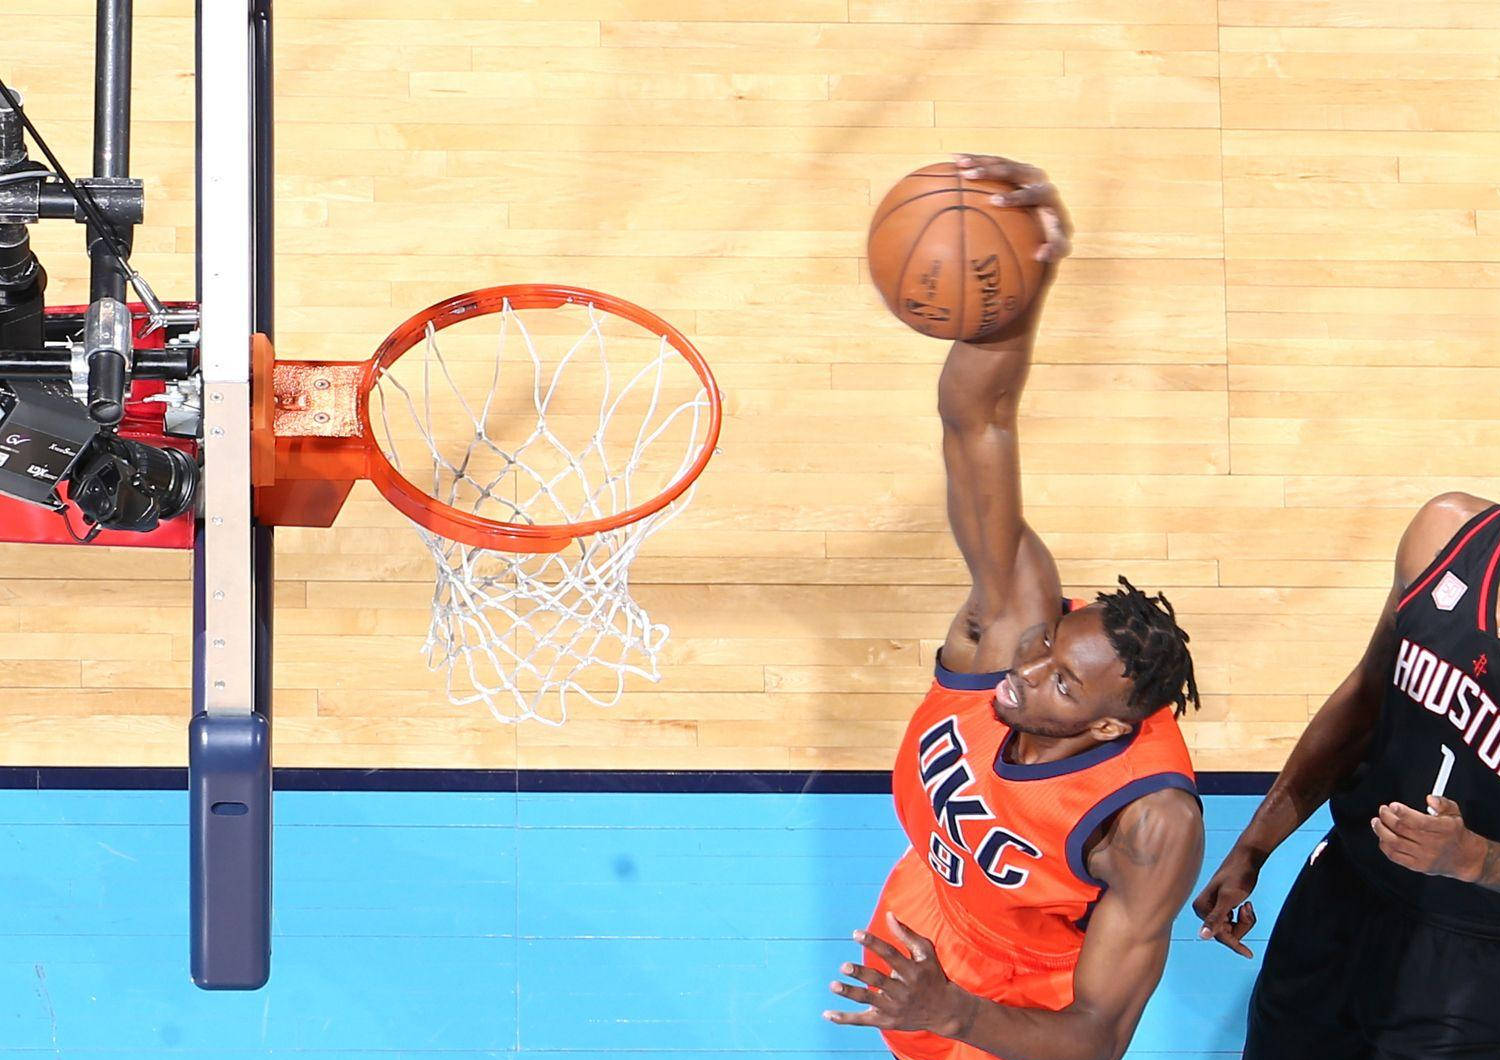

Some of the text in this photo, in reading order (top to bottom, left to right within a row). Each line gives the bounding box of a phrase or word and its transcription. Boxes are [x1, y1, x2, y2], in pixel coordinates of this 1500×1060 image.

[918, 714, 1044, 889] OKC
[1426, 743, 1456, 817] 1
[928, 830, 965, 888] 9
